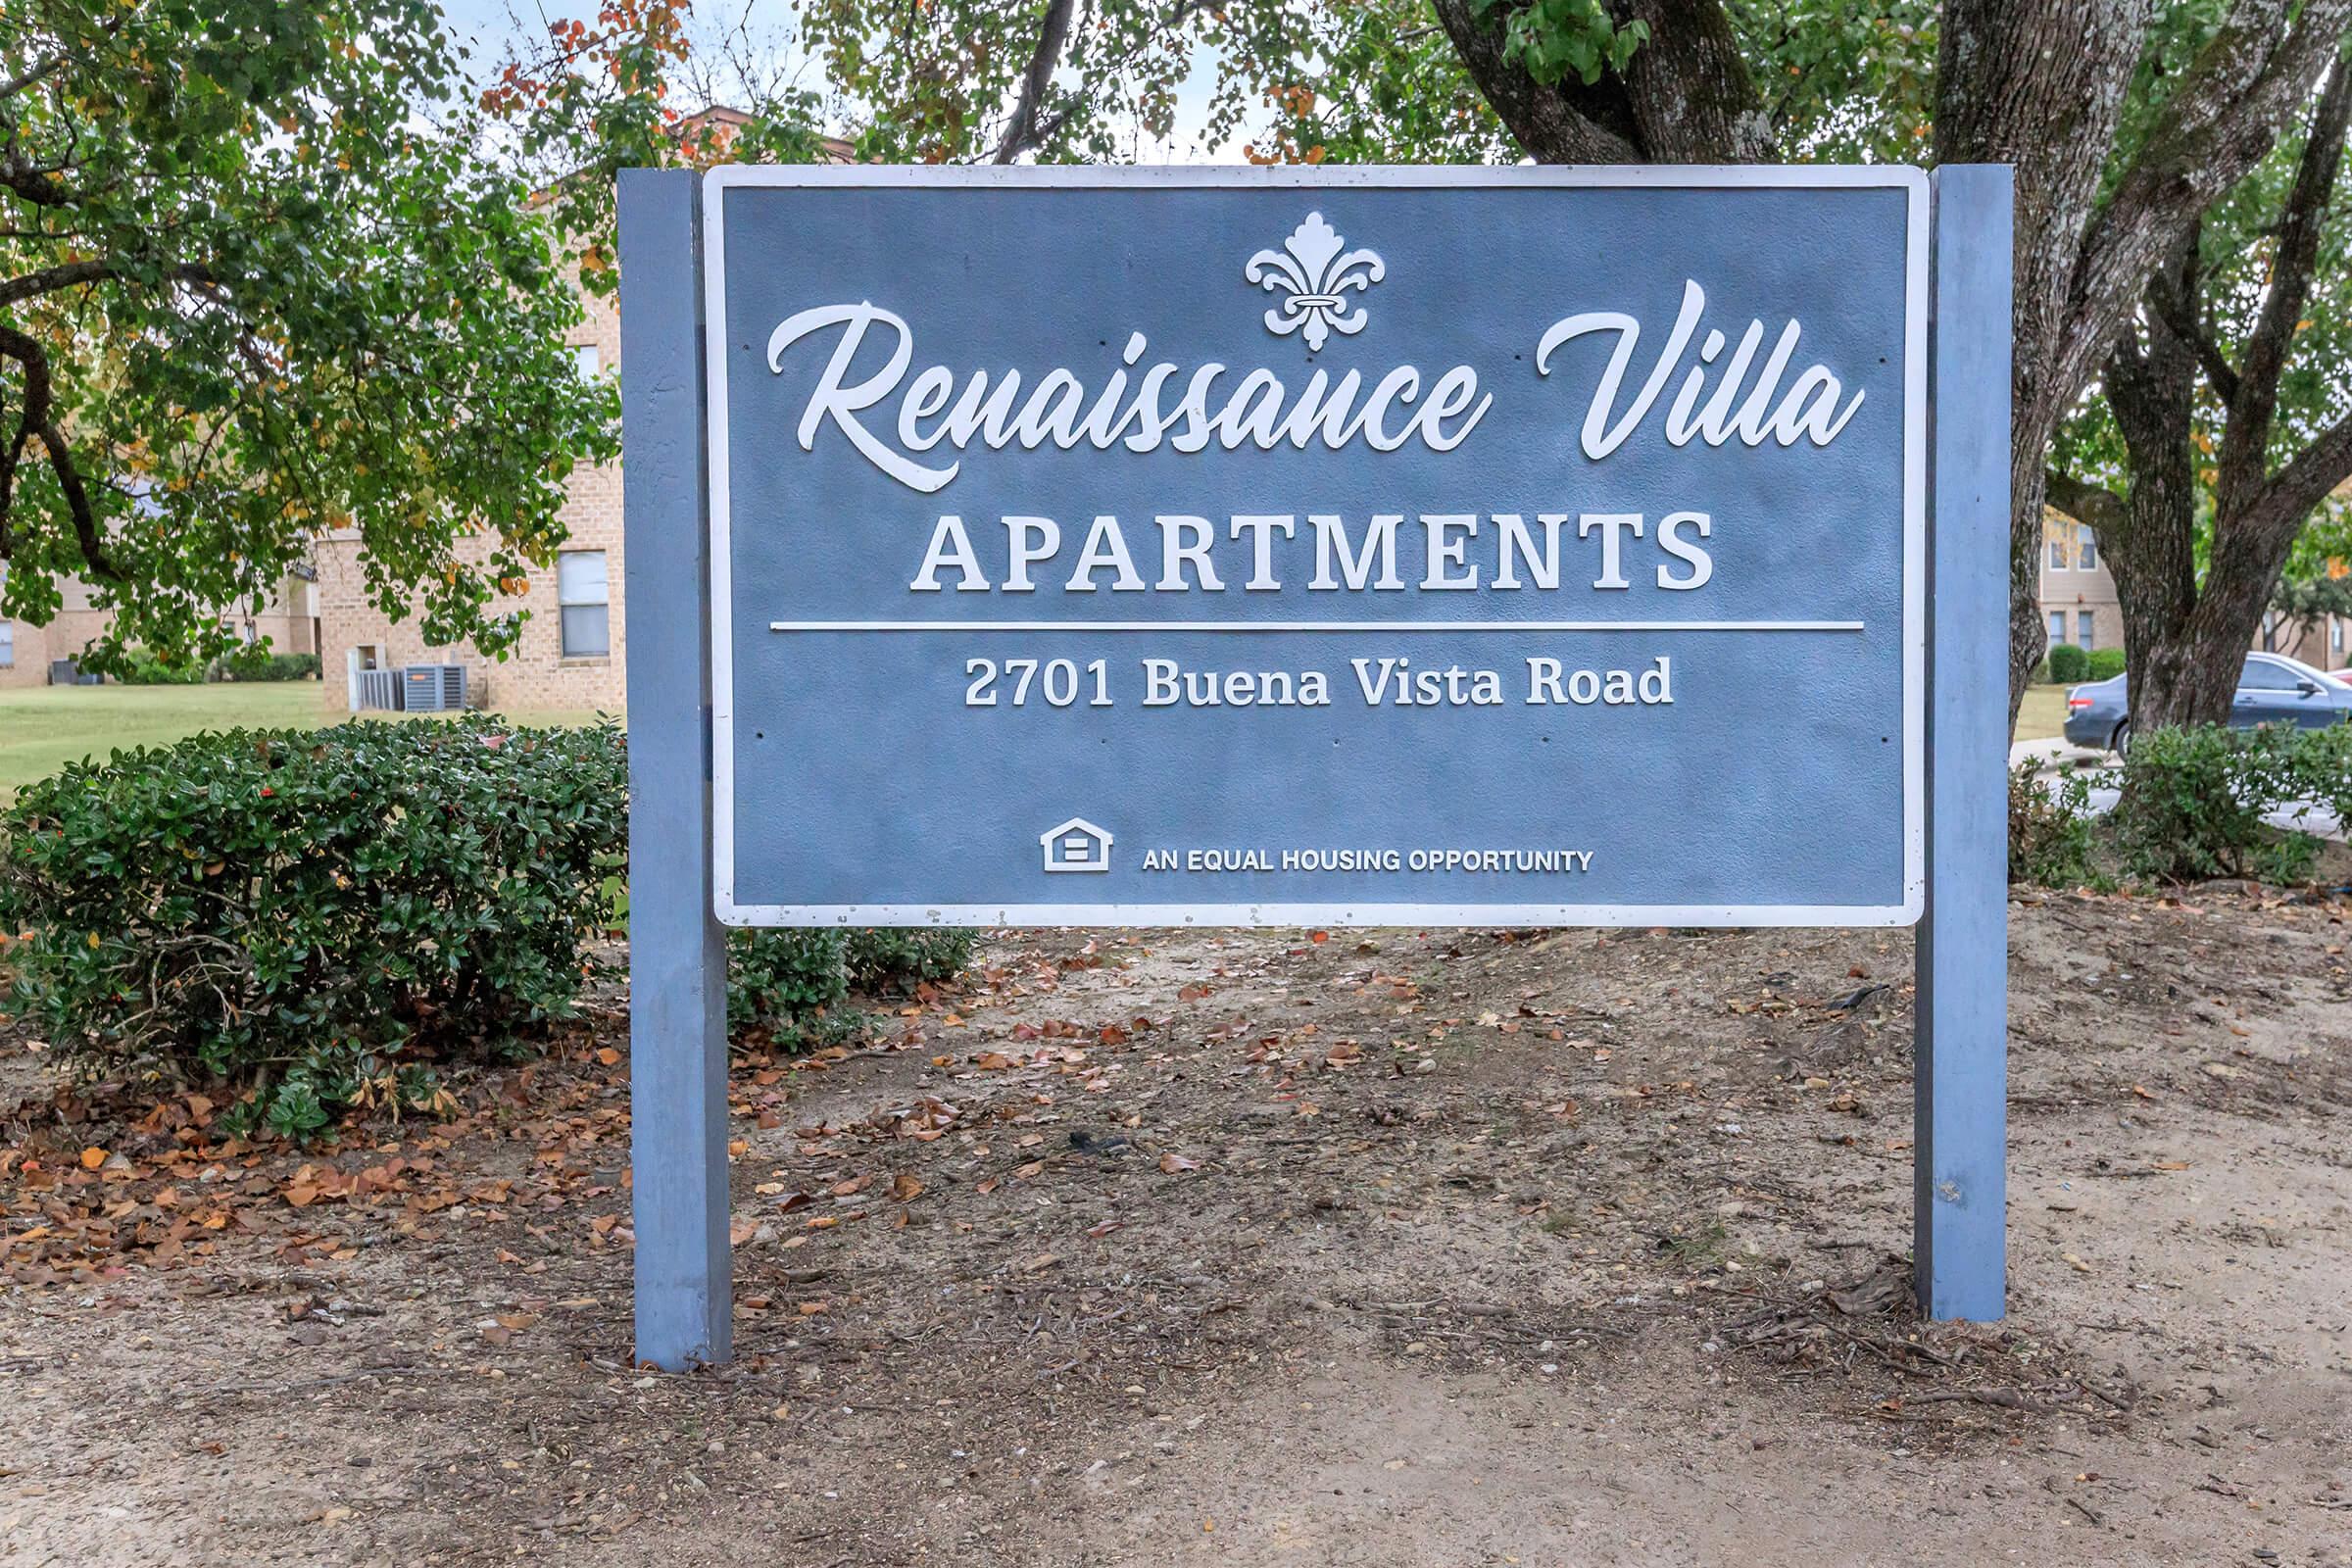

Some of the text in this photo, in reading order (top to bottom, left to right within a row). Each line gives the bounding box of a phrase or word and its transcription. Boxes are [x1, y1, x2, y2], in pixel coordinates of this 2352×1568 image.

[766, 278, 1866, 493] Renaissance Villa
[909, 511, 1713, 591] APARTMENTS
[965, 656, 1675, 706] 2701 Buena Vista Road
[1143, 849, 1593, 871] AN EQUAL HOUSING OPPORTUNITY
